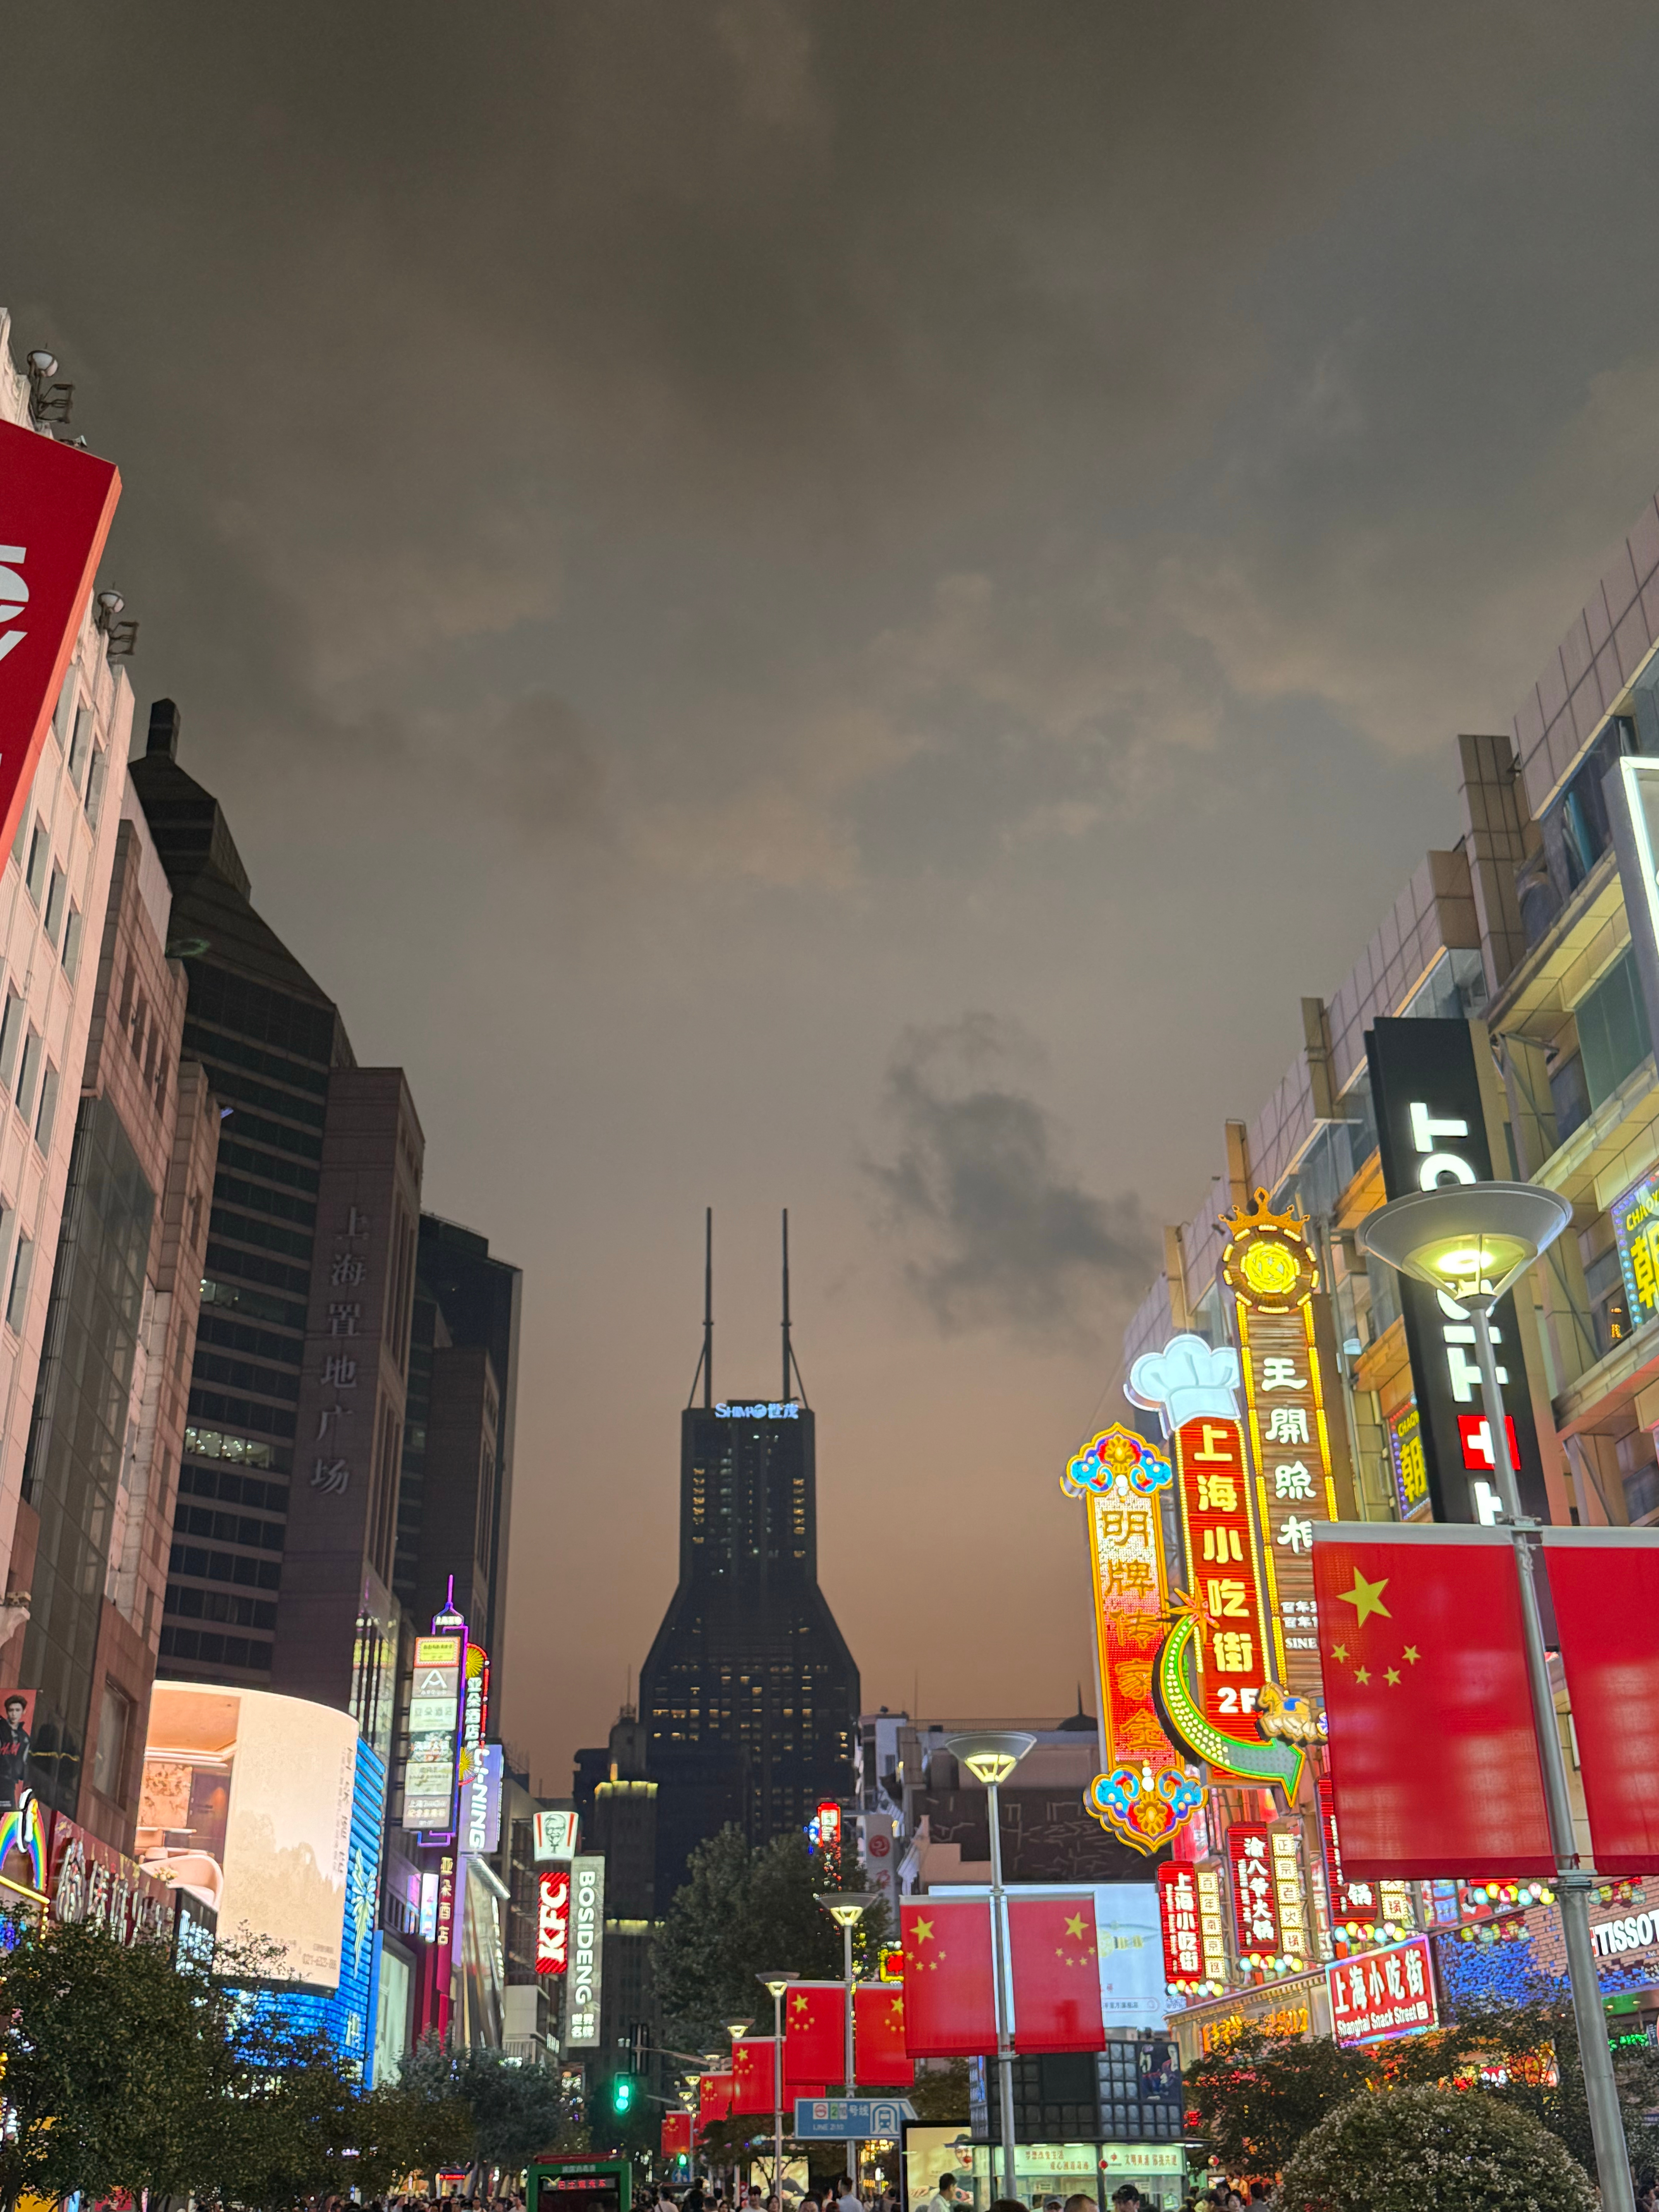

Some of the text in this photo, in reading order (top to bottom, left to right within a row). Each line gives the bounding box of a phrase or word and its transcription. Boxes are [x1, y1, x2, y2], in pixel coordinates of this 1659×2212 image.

[1410, 1103, 1509, 1403] TIOT
[311, 1206, 369, 1495] 上海置地广场
[1194, 1424, 1253, 1672] 上海小吃街
[1217, 1688, 1259, 1714] 2F
[438, 1857, 453, 1945] 亚朵酒店
[538, 1881, 567, 1962] KFC
[575, 1871, 595, 2005] BOSIDENG
[1174, 1872, 1198, 1972] 上海小吃街
[1335, 1949, 1424, 2014] 上海小吃街
[1337, 2004, 1417, 2037] Shanghai Snack Street
[850, 2105, 869, 2117] 号线
